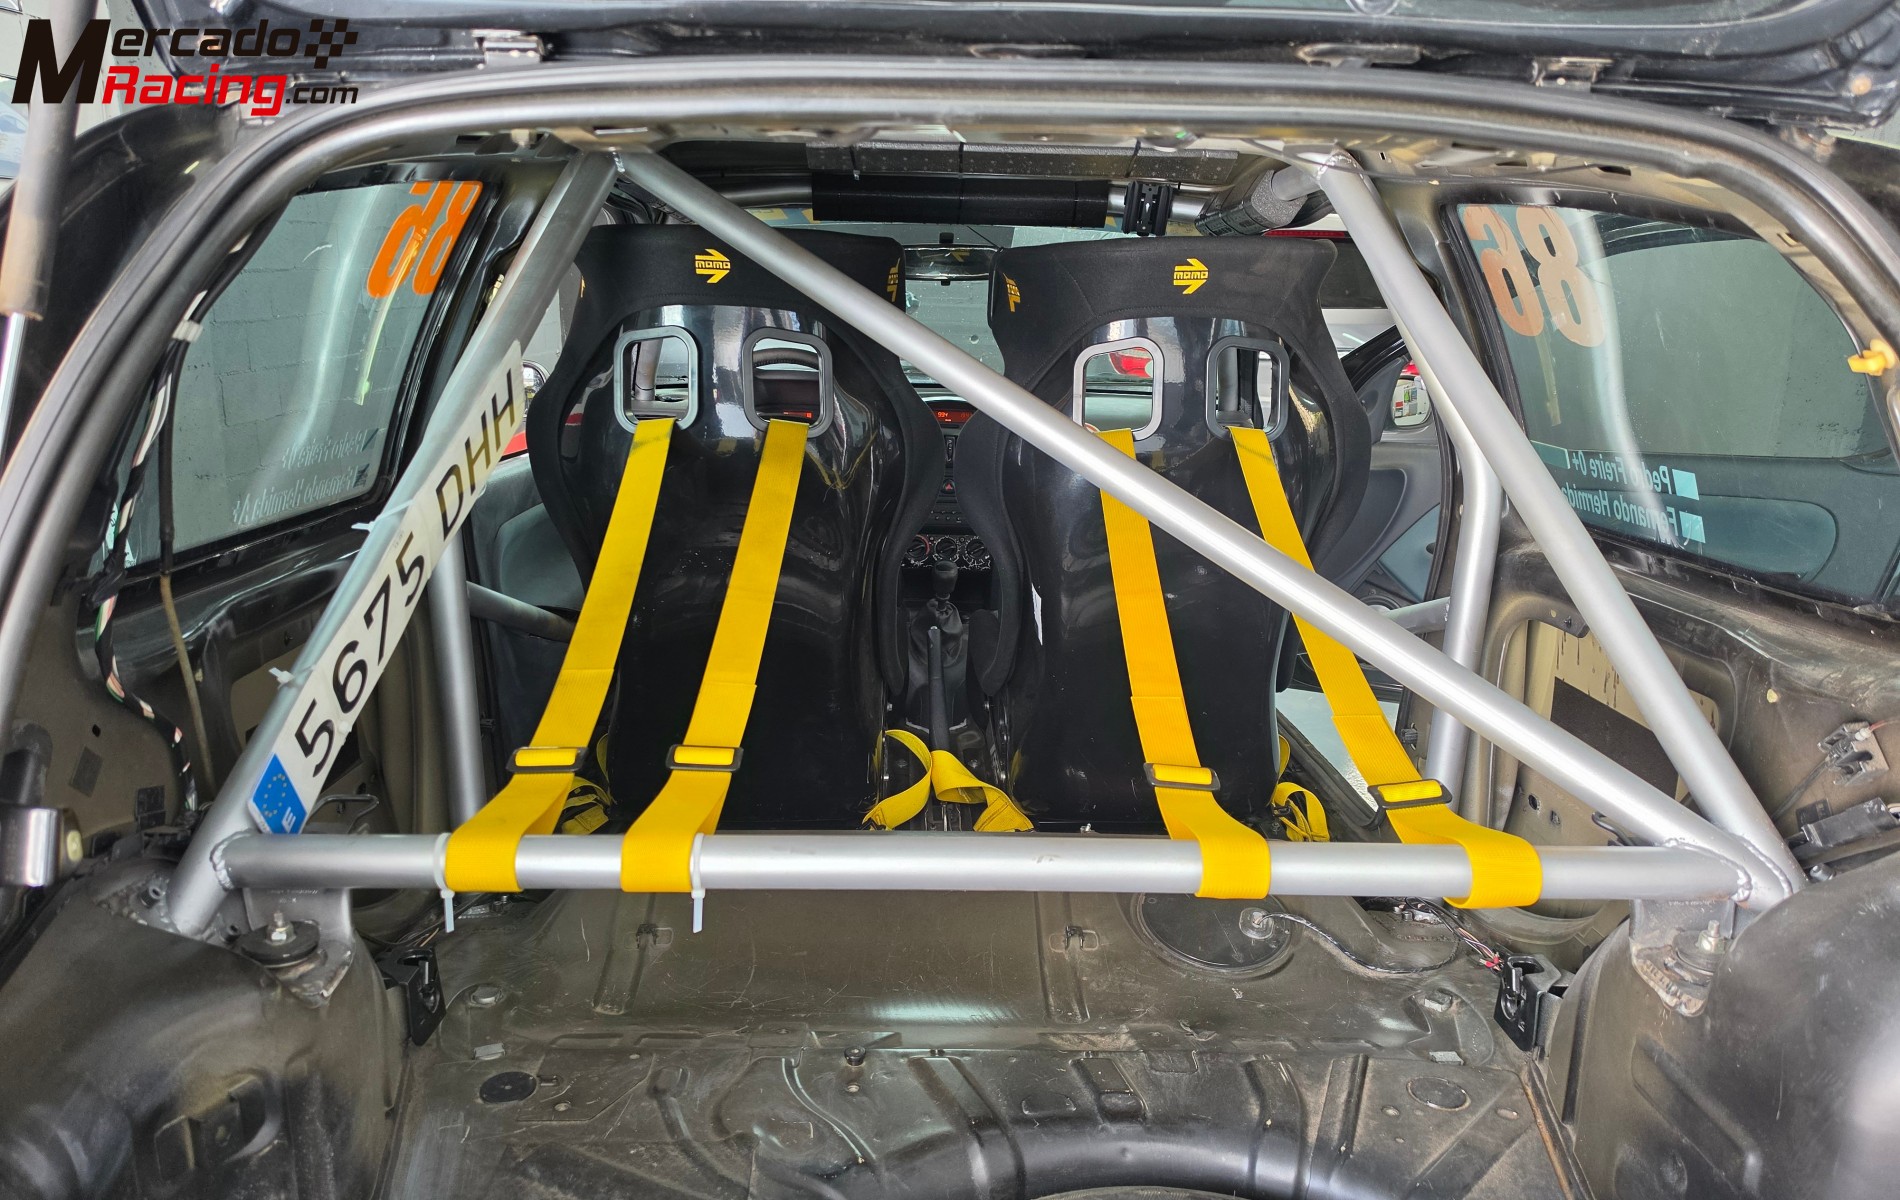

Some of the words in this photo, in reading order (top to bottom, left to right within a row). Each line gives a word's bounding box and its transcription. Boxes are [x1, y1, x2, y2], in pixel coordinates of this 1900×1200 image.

[294, 531, 425, 778] 5675
[435, 368, 517, 541] DHH
[282, 806, 297, 834] E
